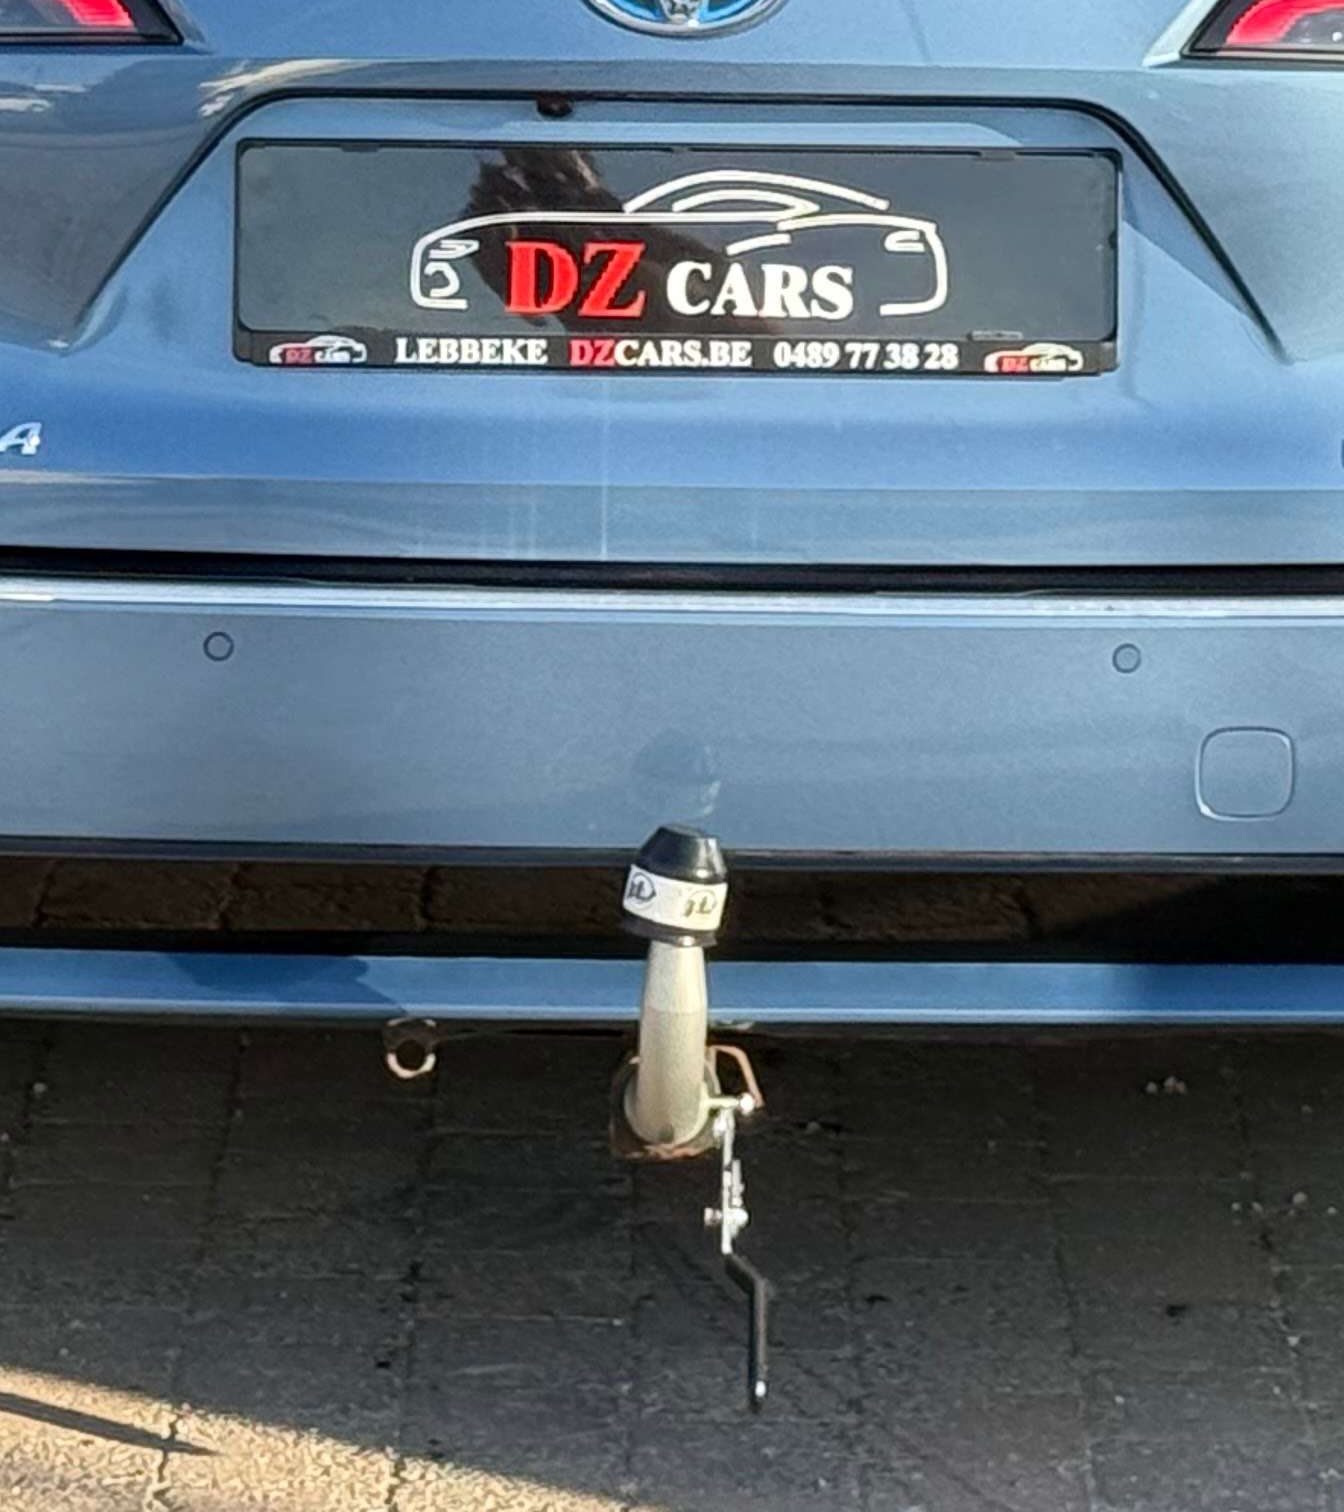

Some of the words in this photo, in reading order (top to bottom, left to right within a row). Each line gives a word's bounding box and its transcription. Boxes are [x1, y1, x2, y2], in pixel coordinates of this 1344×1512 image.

[505, 240, 647, 318] DZ
[666, 261, 854, 320] CARS
[394, 338, 548, 365] LEBBEKE
[569, 339, 753, 368] DZCARS.BE
[773, 341, 840, 368] 0489
[844, 343, 880, 369] 77
[884, 343, 920, 370] 38
[924, 343, 960, 370] 28
